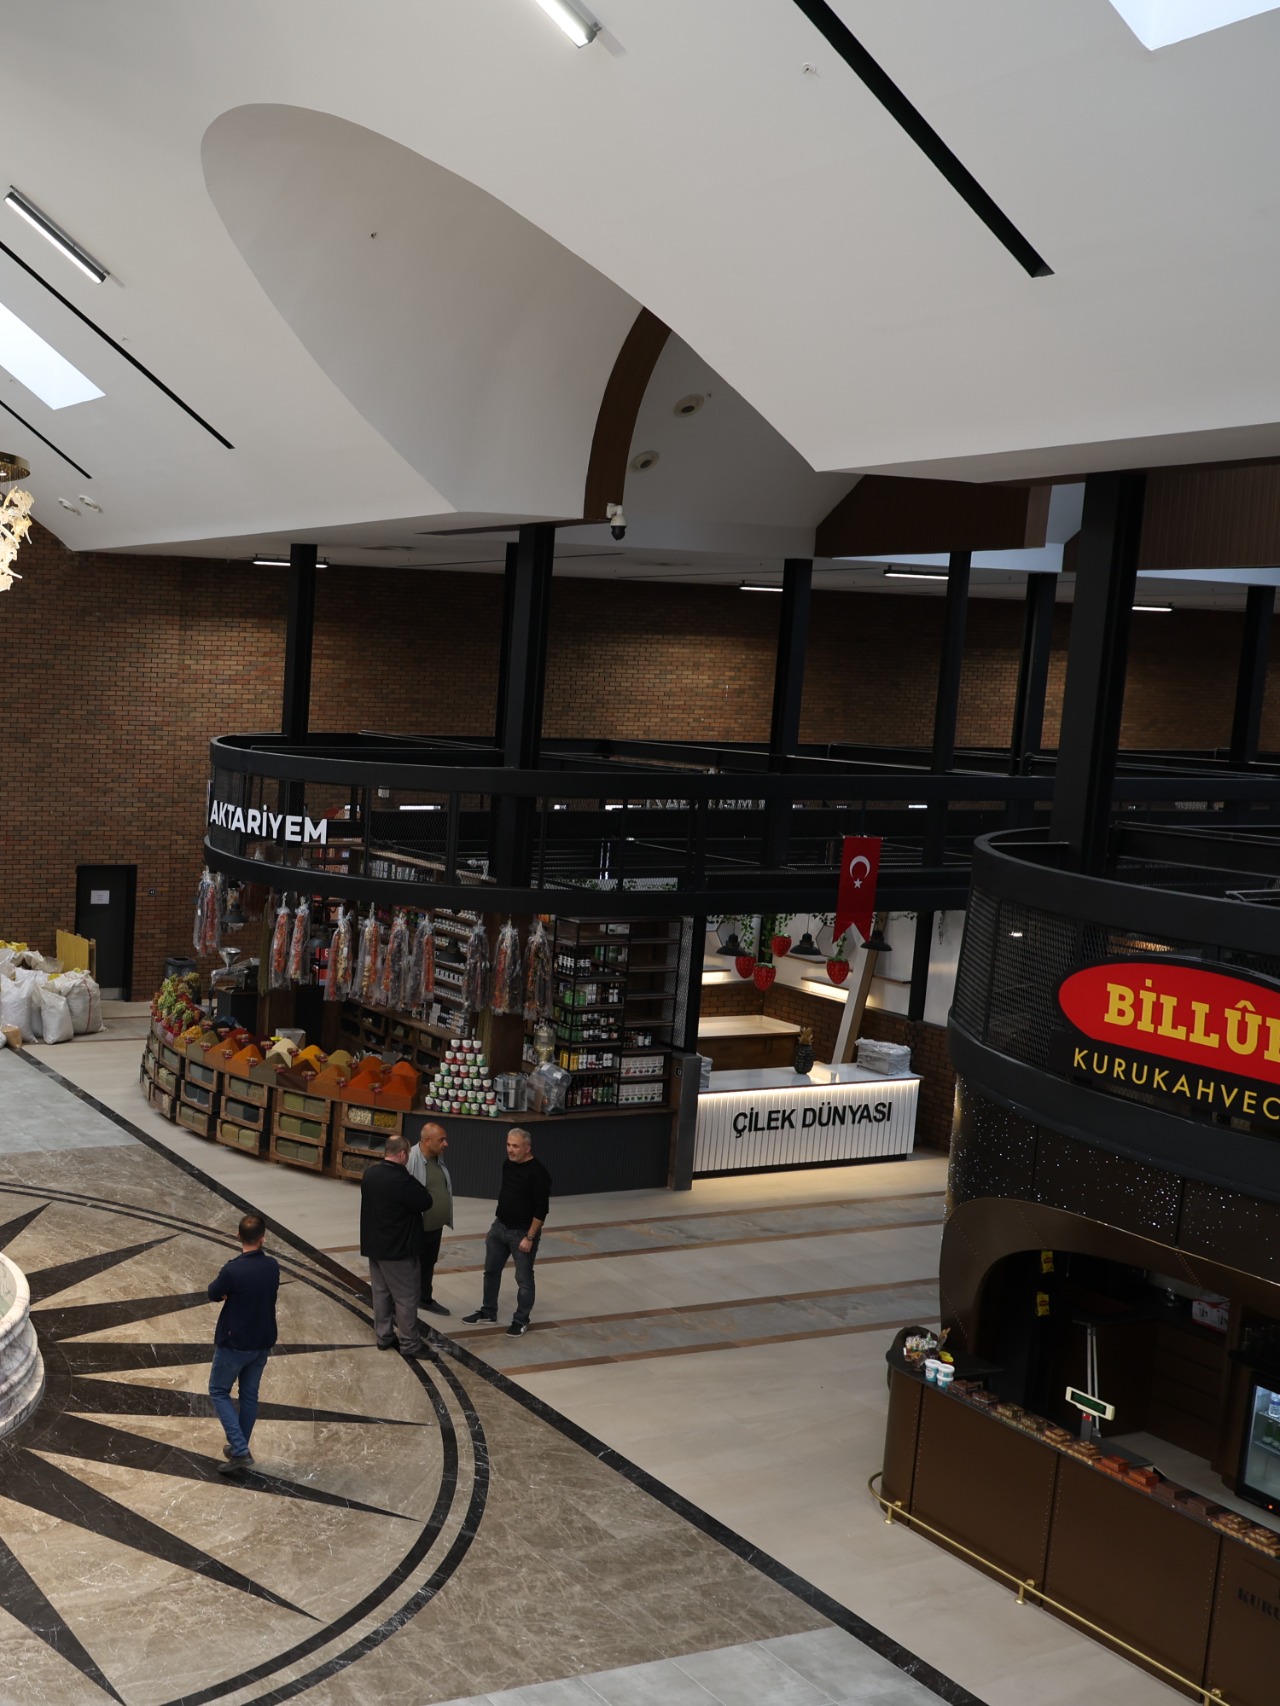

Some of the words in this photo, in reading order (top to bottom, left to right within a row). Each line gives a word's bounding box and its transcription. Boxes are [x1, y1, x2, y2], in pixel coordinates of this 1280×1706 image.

[209, 800, 328, 844] AKTARİYEM
[1073, 1048, 1280, 1120] KURUKAHVEC
[732, 1107, 797, 1139] ÇİLEK
[802, 1101, 893, 1128] DÜNYASI
